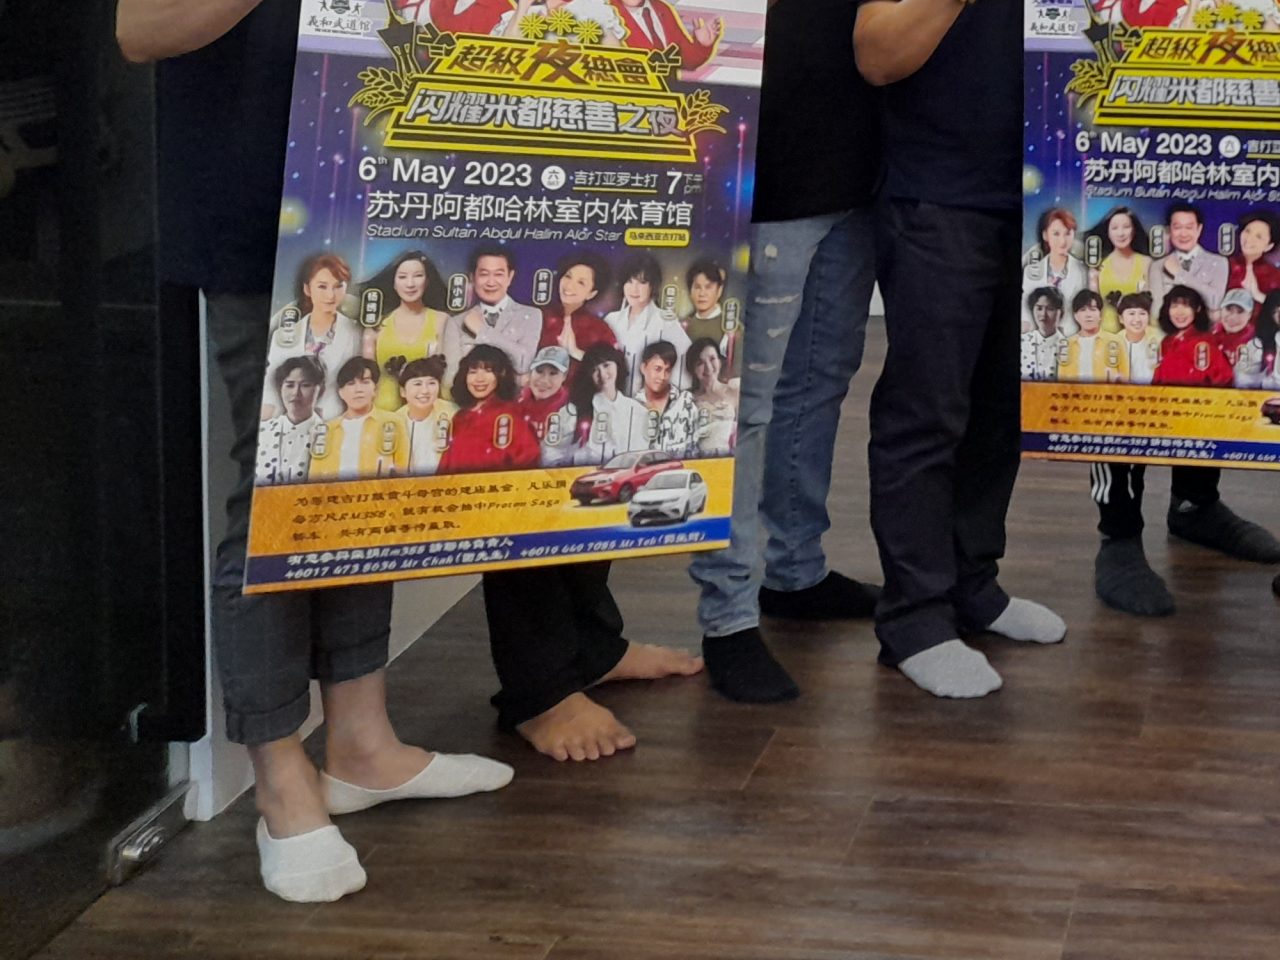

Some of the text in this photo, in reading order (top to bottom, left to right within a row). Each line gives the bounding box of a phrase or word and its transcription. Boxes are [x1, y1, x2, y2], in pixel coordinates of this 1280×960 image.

[448, 39, 650, 85] 超級夜總會
[405, 88, 686, 136] 闪耀米都慈善之夜
[1101, 131, 1150, 158] May
[1156, 132, 1212, 156] 2023
[358, 155, 388, 181] 6th
[392, 157, 456, 189] May
[464, 161, 533, 187] 2023
[573, 170, 682, 195] 吉打亚罗士打 7
[366, 190, 694, 227] 苏丹阿都哈林室内体育馆
[1086, 184, 1133, 198] Stadium
[1134, 185, 1170, 199] Sultan
[1207, 188, 1242, 201] Halim
[1242, 188, 1268, 202] Alor
[366, 223, 623, 242] Stadium Sultan Abdul Halim Alor Star
[400, 558, 418, 569] Mr
[618, 538, 634, 549] Mr
